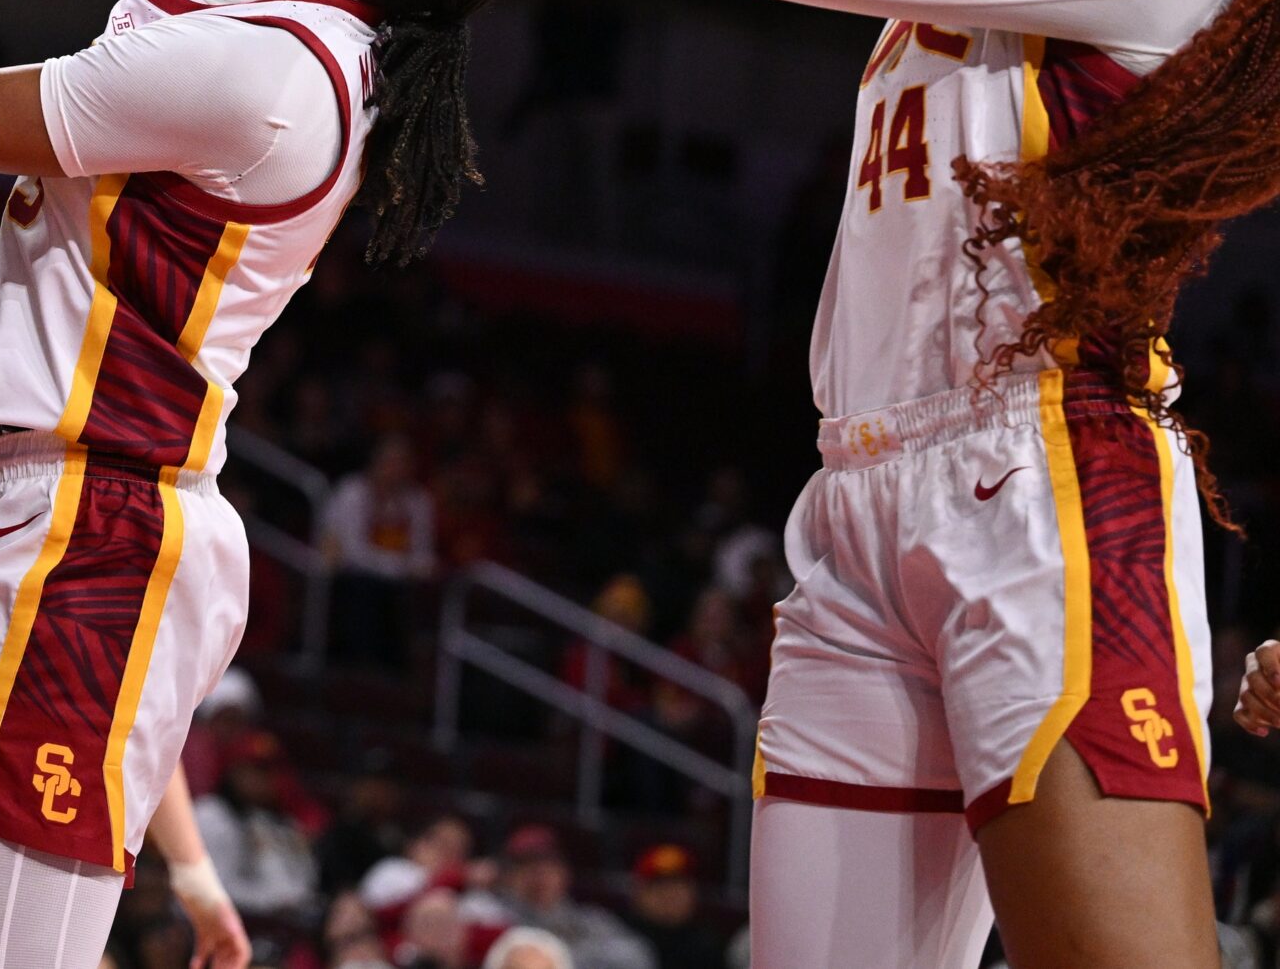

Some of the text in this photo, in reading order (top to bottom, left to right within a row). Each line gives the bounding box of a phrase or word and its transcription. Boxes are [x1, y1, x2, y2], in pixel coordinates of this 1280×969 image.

[857, 84, 932, 215] 44
[1120, 687, 1179, 769] SC
[32, 742, 82, 824] SC
